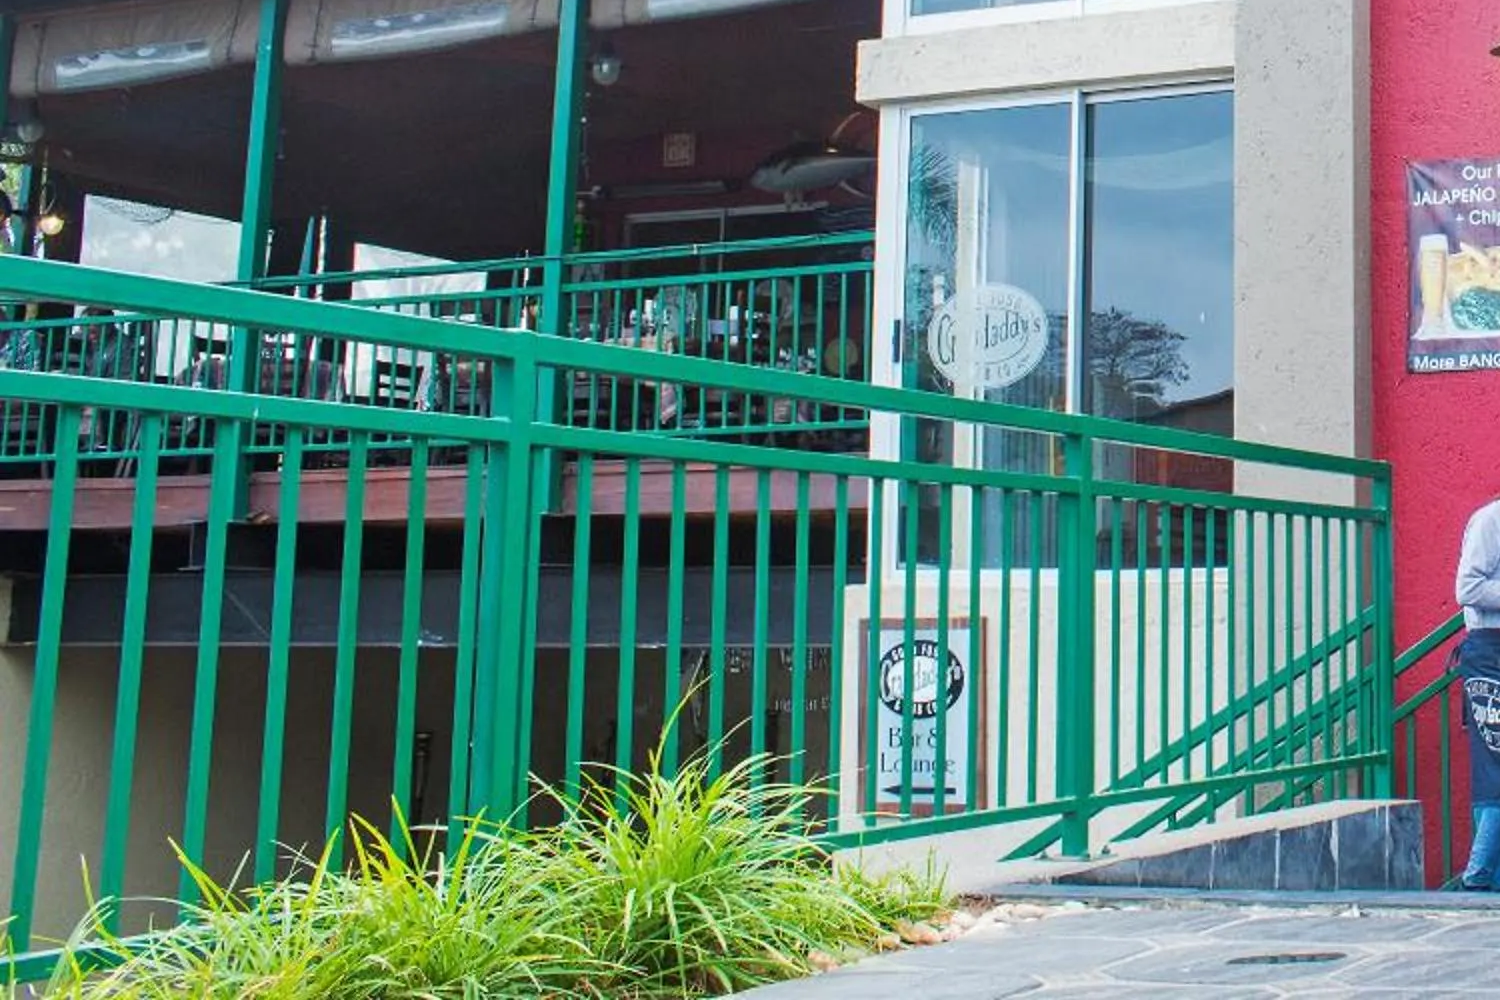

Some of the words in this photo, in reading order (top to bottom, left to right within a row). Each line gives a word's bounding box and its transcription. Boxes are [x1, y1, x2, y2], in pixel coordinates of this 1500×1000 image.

[1462, 165, 1492, 181] Our
[1413, 355, 1455, 370] More
[888, 727, 923, 748] Br
